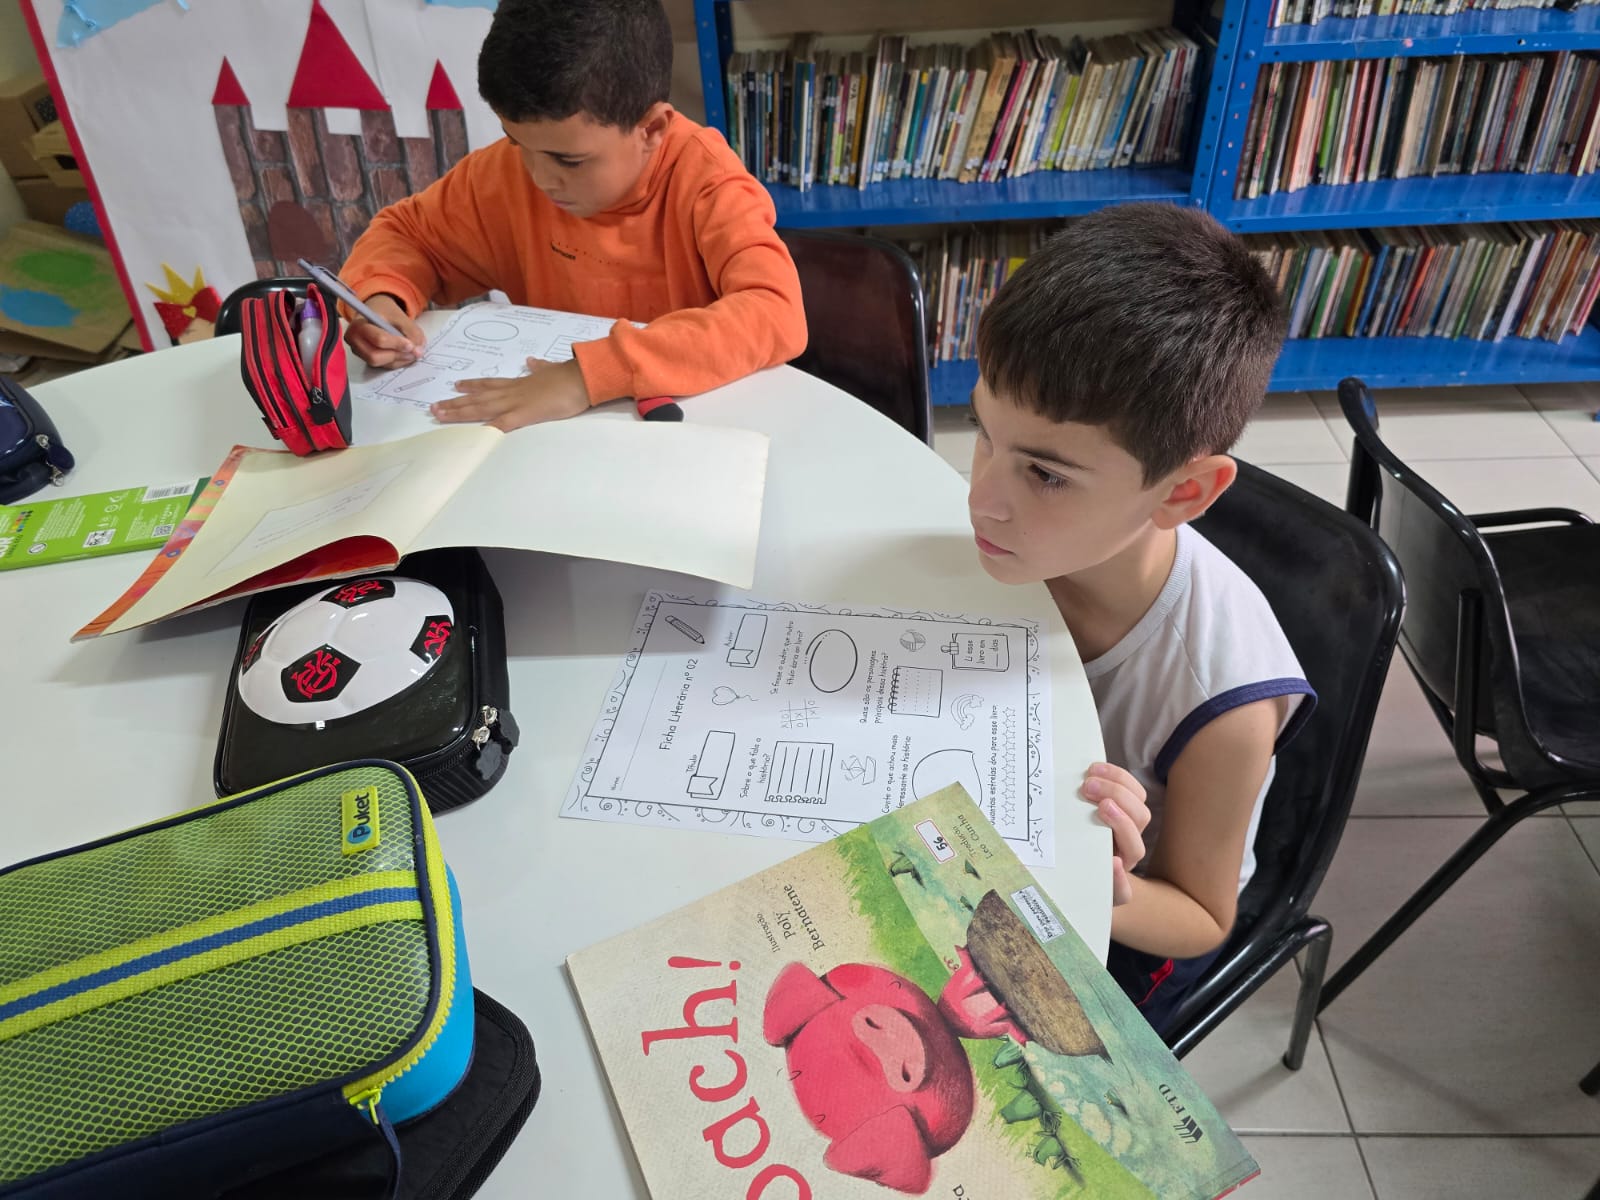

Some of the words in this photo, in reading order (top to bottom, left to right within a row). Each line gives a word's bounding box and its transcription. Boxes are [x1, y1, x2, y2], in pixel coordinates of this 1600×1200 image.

[658, 724, 677, 750] Ficha
[668, 682, 690, 723] Literária
[686, 658, 698, 670] 02
[685, 754, 698, 774] Título
[740, 776, 750, 799] Sobre
[748, 757, 756, 770] que
[759, 753, 770, 784] história?
[352, 791, 371, 839] Puket
[958, 814, 979, 842] Cunha
[933, 836, 948, 852] 56
[980, 844, 994, 860] Leo
[755, 912, 781, 954] Ilustração
[776, 910, 796, 940] Poly
[784, 884, 826, 952] Bernatene
[1158, 1084, 1186, 1114] FTD
